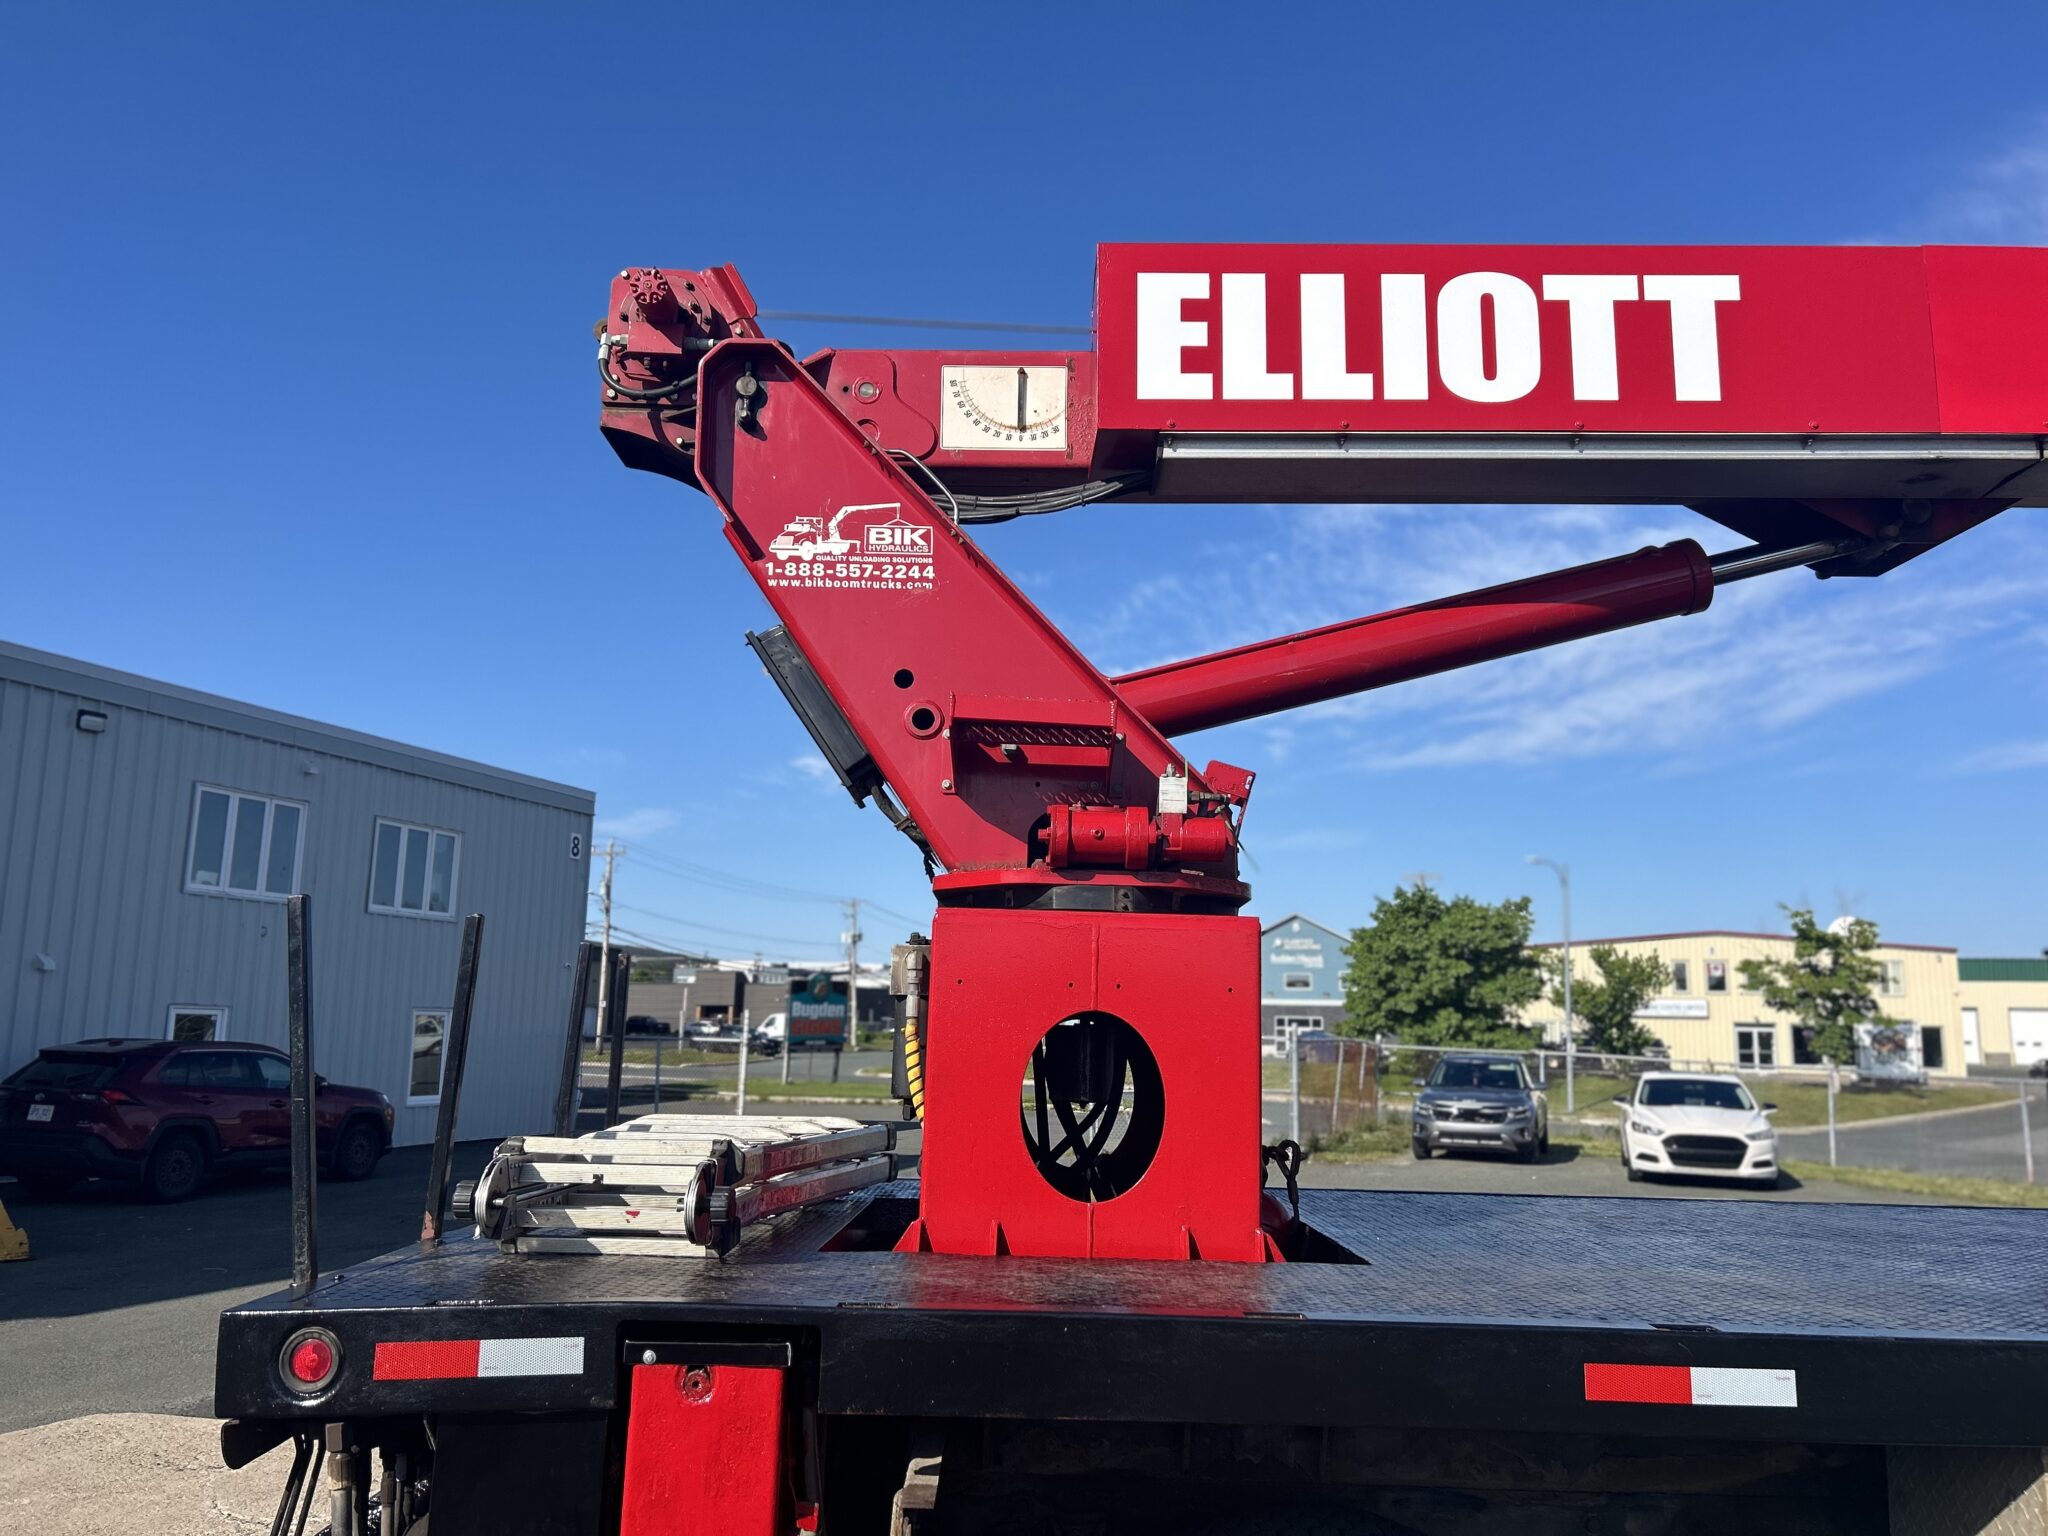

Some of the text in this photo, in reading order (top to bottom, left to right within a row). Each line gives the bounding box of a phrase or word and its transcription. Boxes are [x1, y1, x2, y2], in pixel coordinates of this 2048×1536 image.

[1136, 271, 1741, 403] ELLIOTT
[868, 528, 928, 545] BIK
[868, 544, 929, 553] HYDRAULICS
[848, 555, 891, 563] UNLOADING
[892, 556, 933, 564] SOLUTIONS
[765, 562, 936, 579] 1-888-557-2244
[571, 836, 580, 857] 8
[792, 1001, 845, 1020] Bugden
